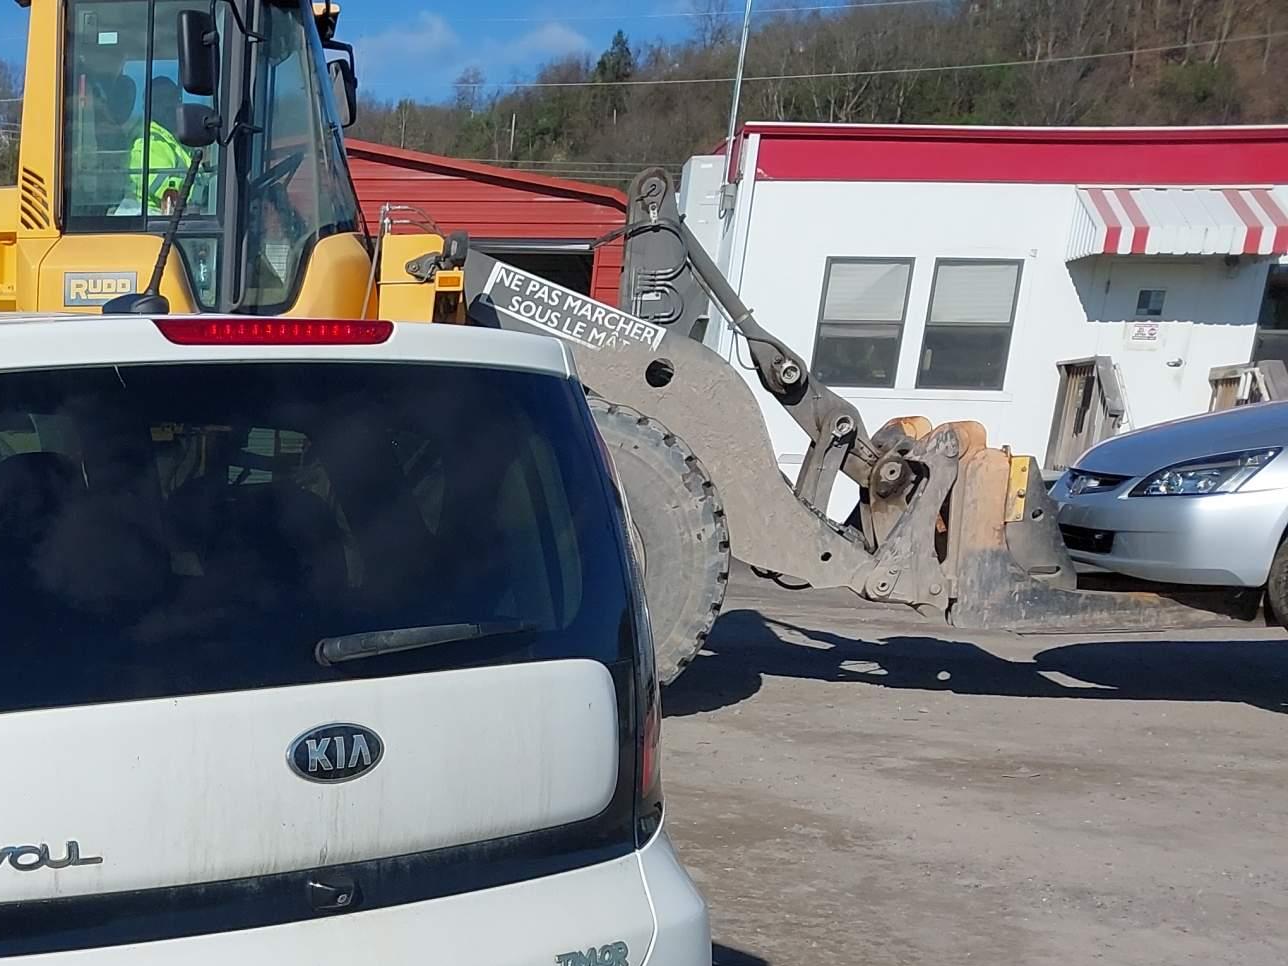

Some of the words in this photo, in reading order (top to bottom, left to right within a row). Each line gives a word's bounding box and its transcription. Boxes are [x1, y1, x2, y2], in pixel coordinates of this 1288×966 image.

[70, 278, 131, 300] RUDD
[495, 268, 525, 292] NE
[525, 280, 562, 307] PAS
[562, 296, 656, 345] MARCHER
[508, 296, 562, 328] SOUS
[562, 318, 587, 338] LE
[305, 733, 372, 772] KIA
